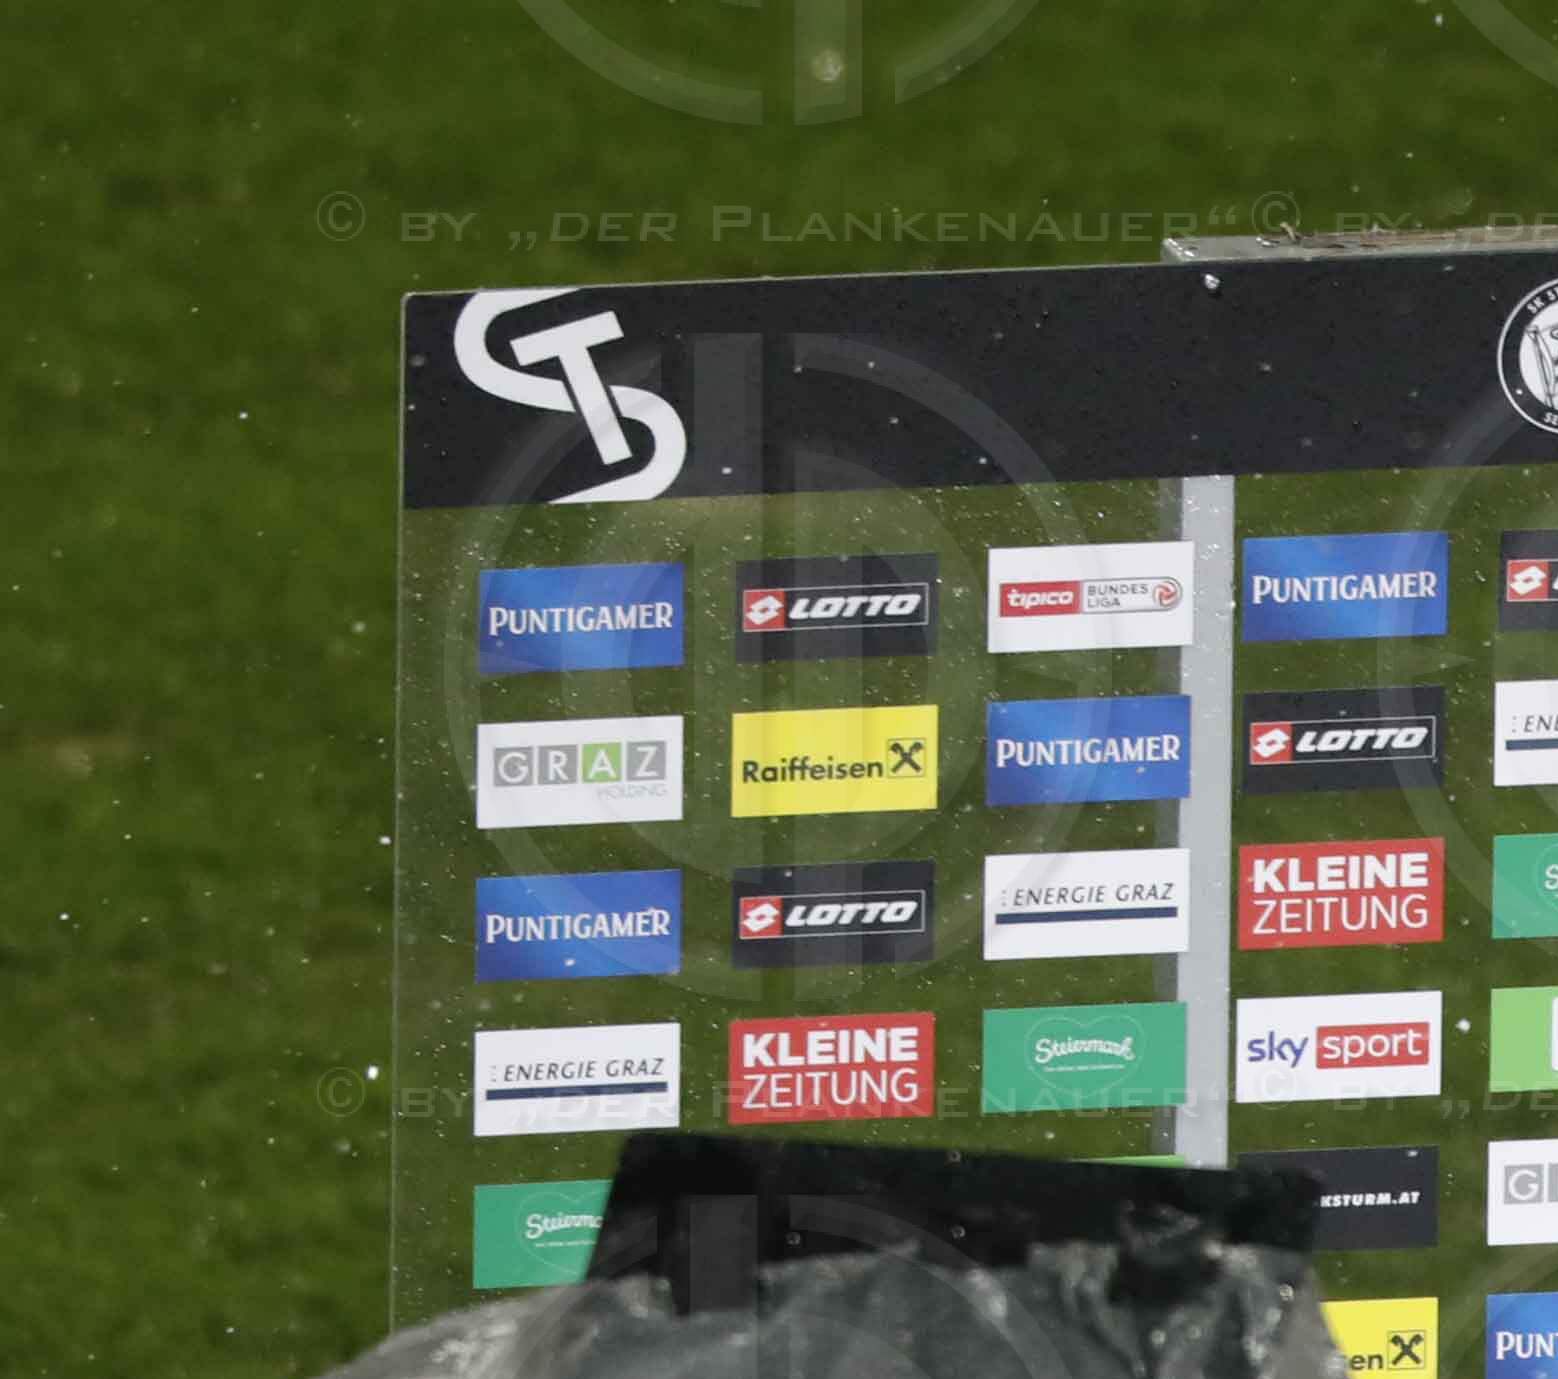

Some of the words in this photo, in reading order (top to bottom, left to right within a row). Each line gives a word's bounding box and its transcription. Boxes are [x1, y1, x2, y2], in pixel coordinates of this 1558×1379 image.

[1007, 588, 1074, 610] tipico
[1086, 583, 1148, 597] BUNDES
[1086, 597, 1121, 609] LIGA
[1253, 571, 1436, 604] PUNTIGAMER
[489, 602, 672, 635] PUNTIGAMER
[788, 593, 921, 620] LOTTO
[498, 747, 658, 783] GRAZ
[996, 735, 1179, 768] PUNTIGAMER
[743, 755, 883, 783] Raiffeisen
[1253, 852, 1429, 893] KLEINE
[1013, 886, 1107, 908] ENERGIE
[1115, 883, 1175, 904] GRAZ
[486, 910, 669, 943] PUNTIGAMER
[785, 900, 918, 927] LOTTO
[1252, 893, 1428, 934] ZEITUNG
[743, 1027, 919, 1068] KLEINE
[1034, 1036, 1134, 1064] Steiermark
[1246, 1030, 1309, 1069] sky
[1322, 1029, 1422, 1066] sport
[503, 1061, 597, 1083] ENERGIE
[605, 1058, 665, 1079] GRAZ
[742, 1068, 918, 1109] ZEITUNG
